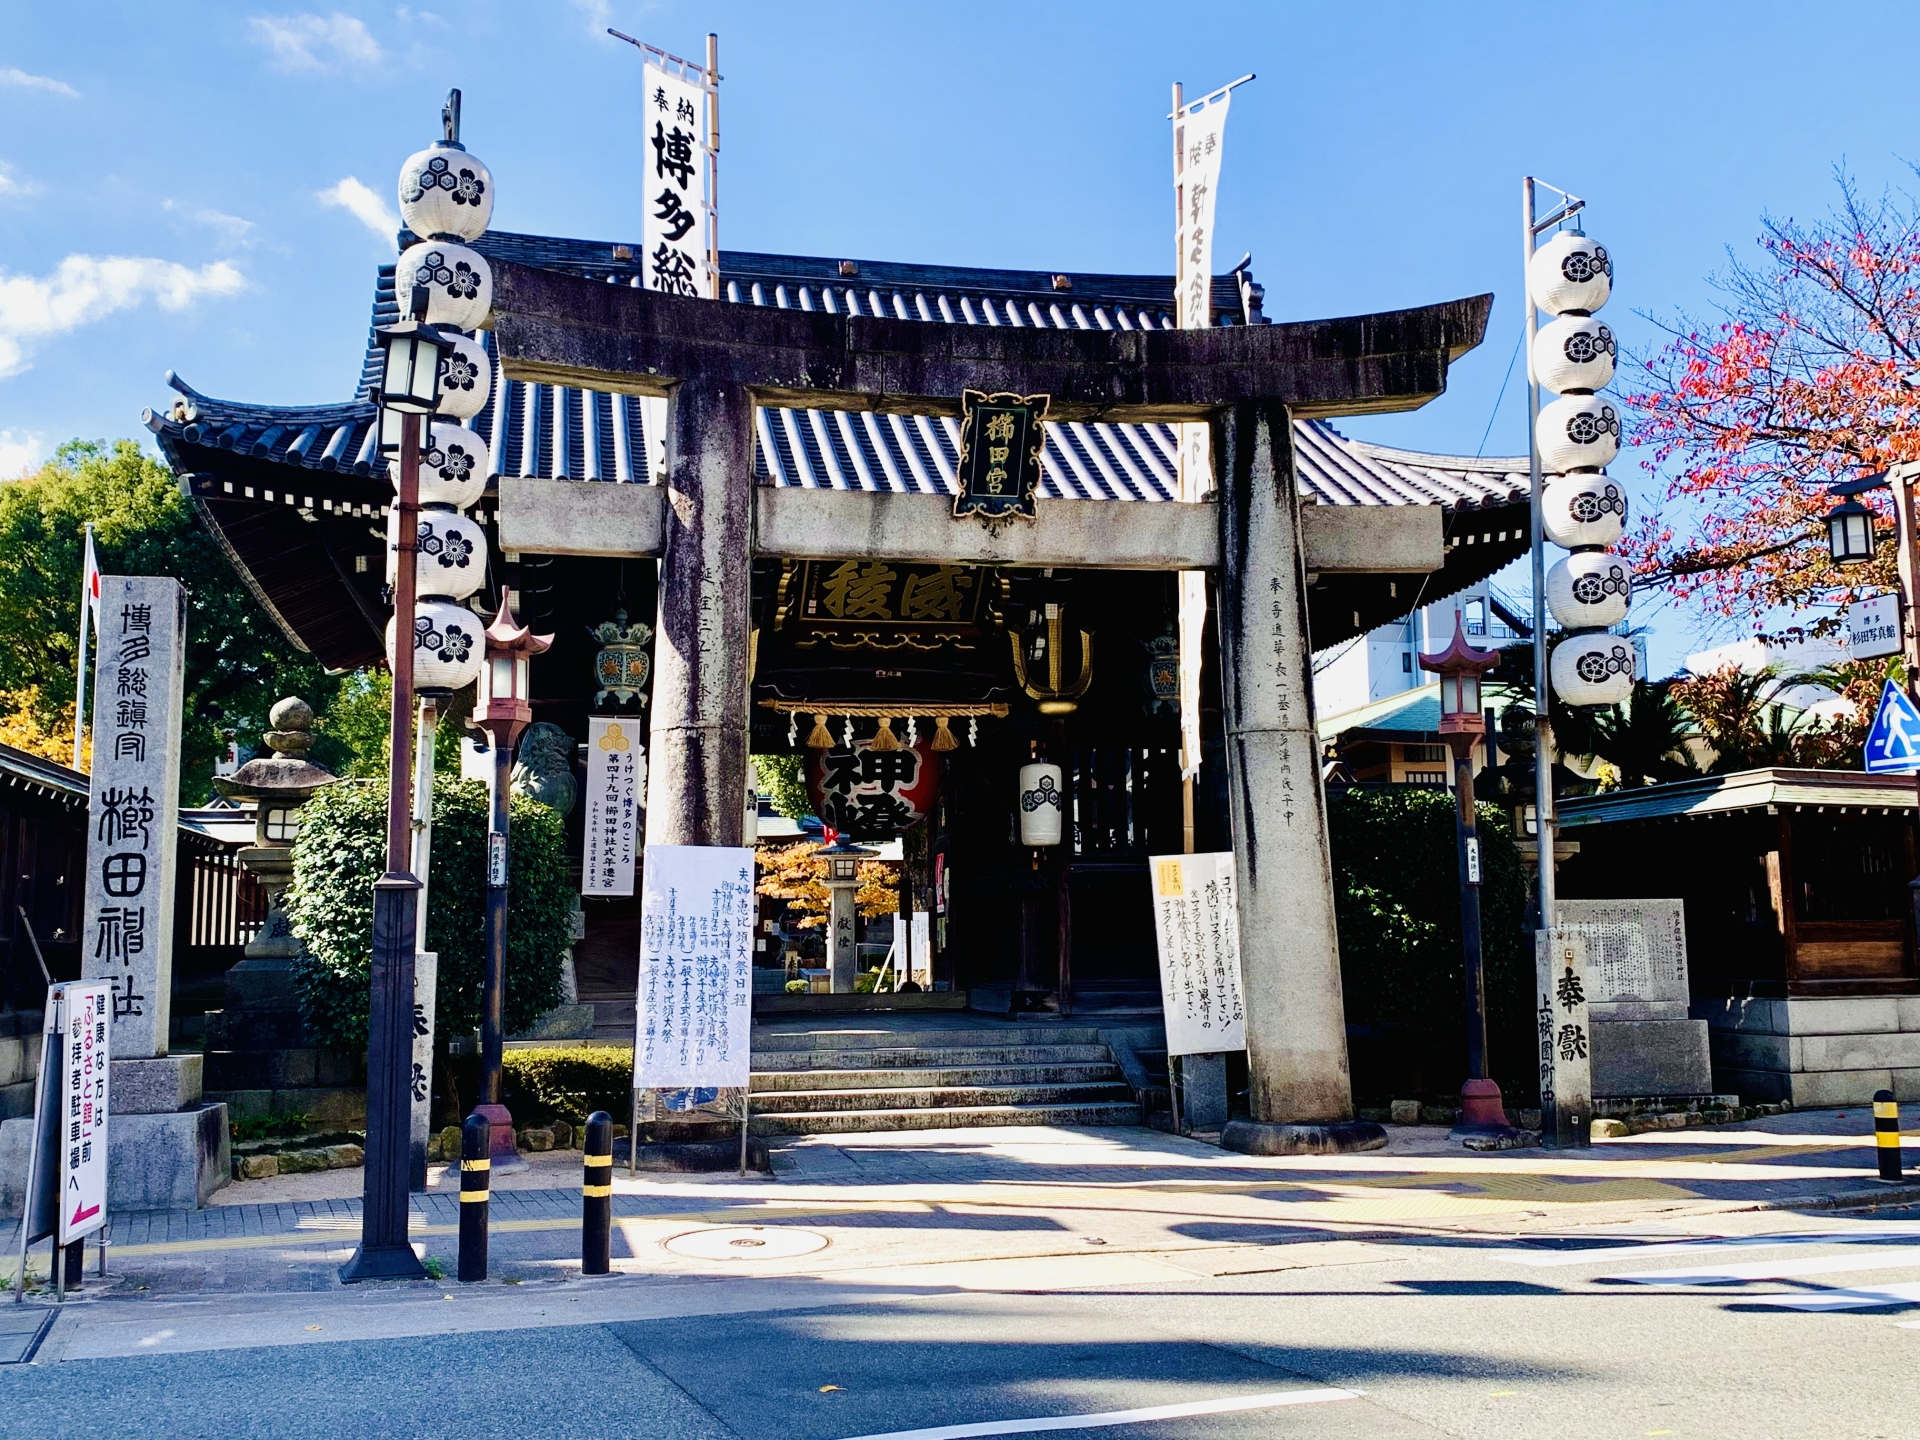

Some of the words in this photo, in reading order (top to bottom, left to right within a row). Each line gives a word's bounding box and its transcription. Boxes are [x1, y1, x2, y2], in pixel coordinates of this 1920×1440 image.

[653, 86, 694, 126] 奉納
[651, 120, 698, 297] 博多総
[984, 412, 1015, 494] 櫛田宮
[1852, 624, 1896, 645] 杉田写真館
[1863, 614, 1880, 625] 博多
[621, 752, 634, 864] うけつぐ博多のこころ
[732, 867, 751, 1007] 夫婦恵比須大祭日程
[69, 1016, 83, 1192] 参拝者駐車場へ
[81, 994, 94, 1163] 「ふるさと館」前
[95, 994, 106, 1128] 健康な方は
